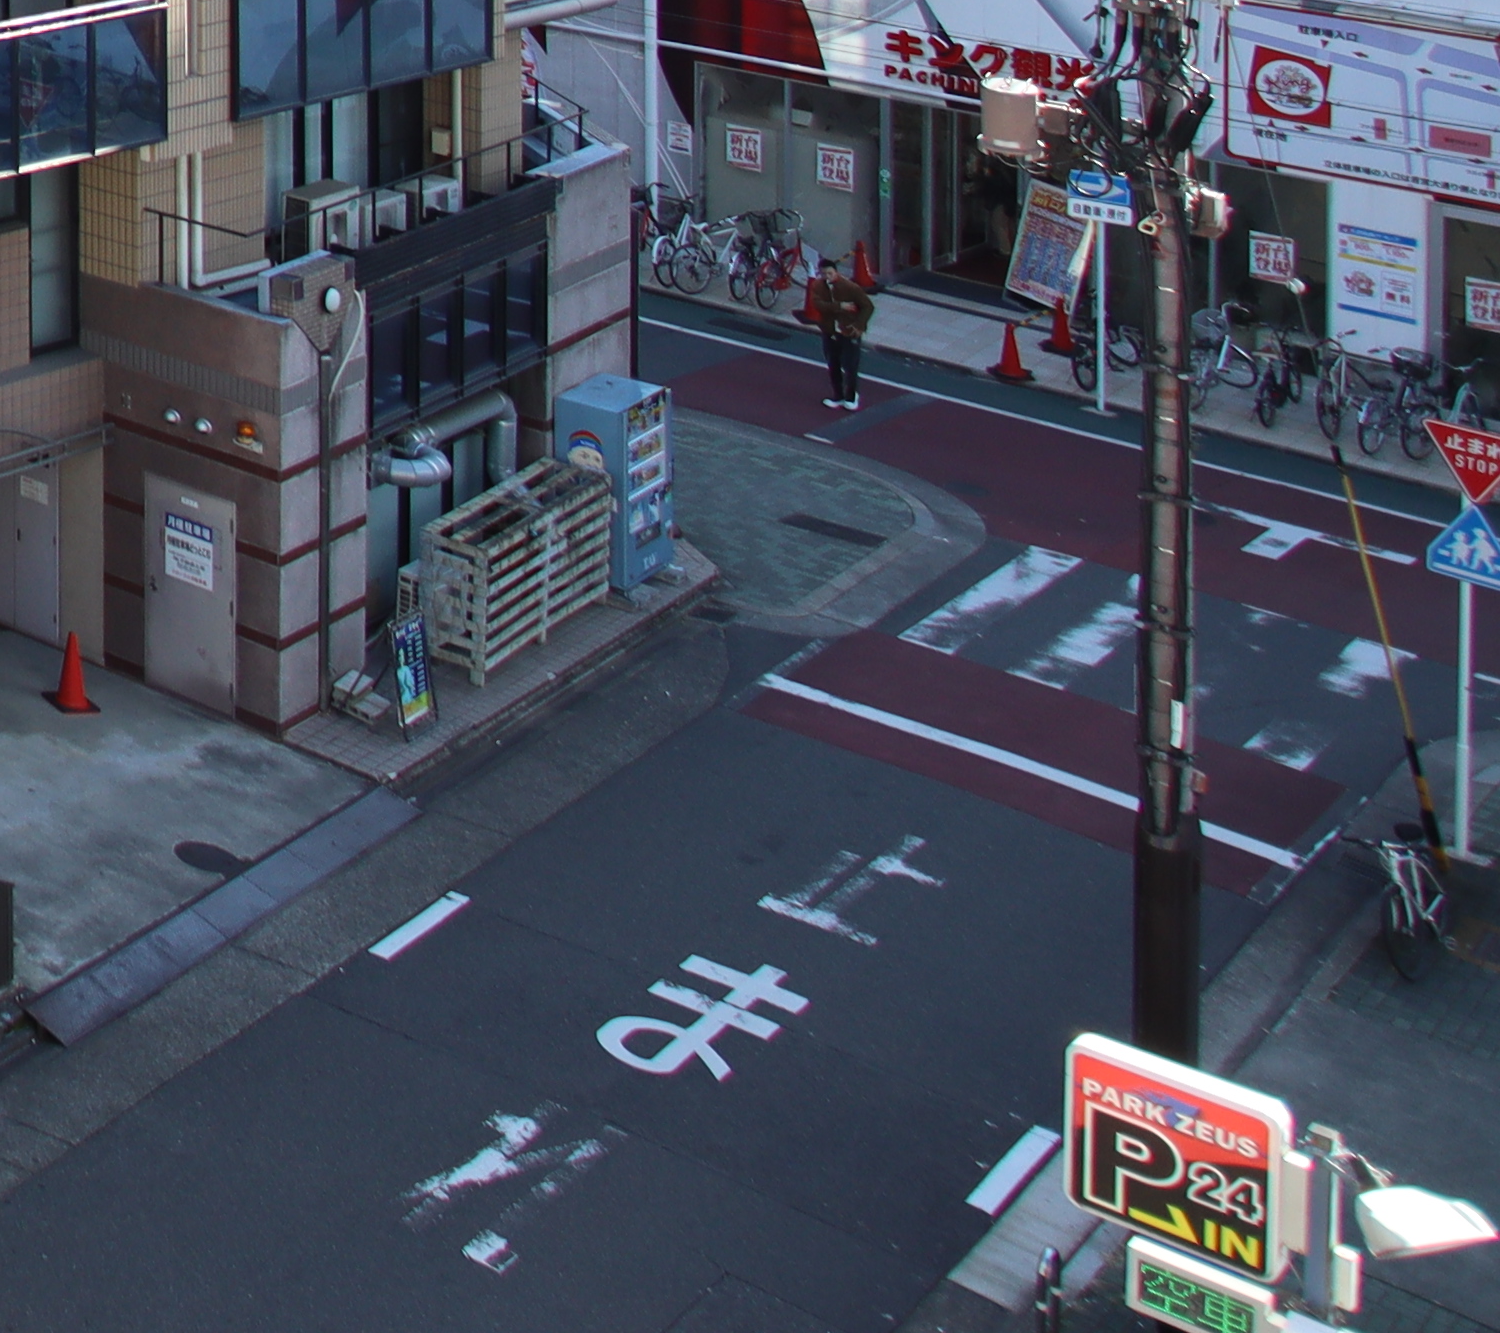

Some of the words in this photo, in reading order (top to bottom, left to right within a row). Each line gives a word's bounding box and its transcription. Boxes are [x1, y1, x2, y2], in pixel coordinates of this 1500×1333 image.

[1298, 24, 1359, 43] 駐車場入口
[884, 29, 1095, 91] キング観光
[730, 132, 758, 149] 新台
[731, 146, 758, 163] 登場
[821, 152, 850, 169] 新台
[822, 166, 850, 183] 登場
[1254, 241, 1290, 259] 新台
[1255, 256, 1291, 275] 登場
[1454, 453, 1498, 476] STOP
[1083, 1077, 1168, 1126] PARK
[1174, 1112, 1260, 1159] ZEUS
[1083, 1099, 1186, 1216] P
[1187, 1161, 1266, 1227] 24
[1203, 1218, 1262, 1270] IN
[1140, 1264, 1256, 1333] 空車
